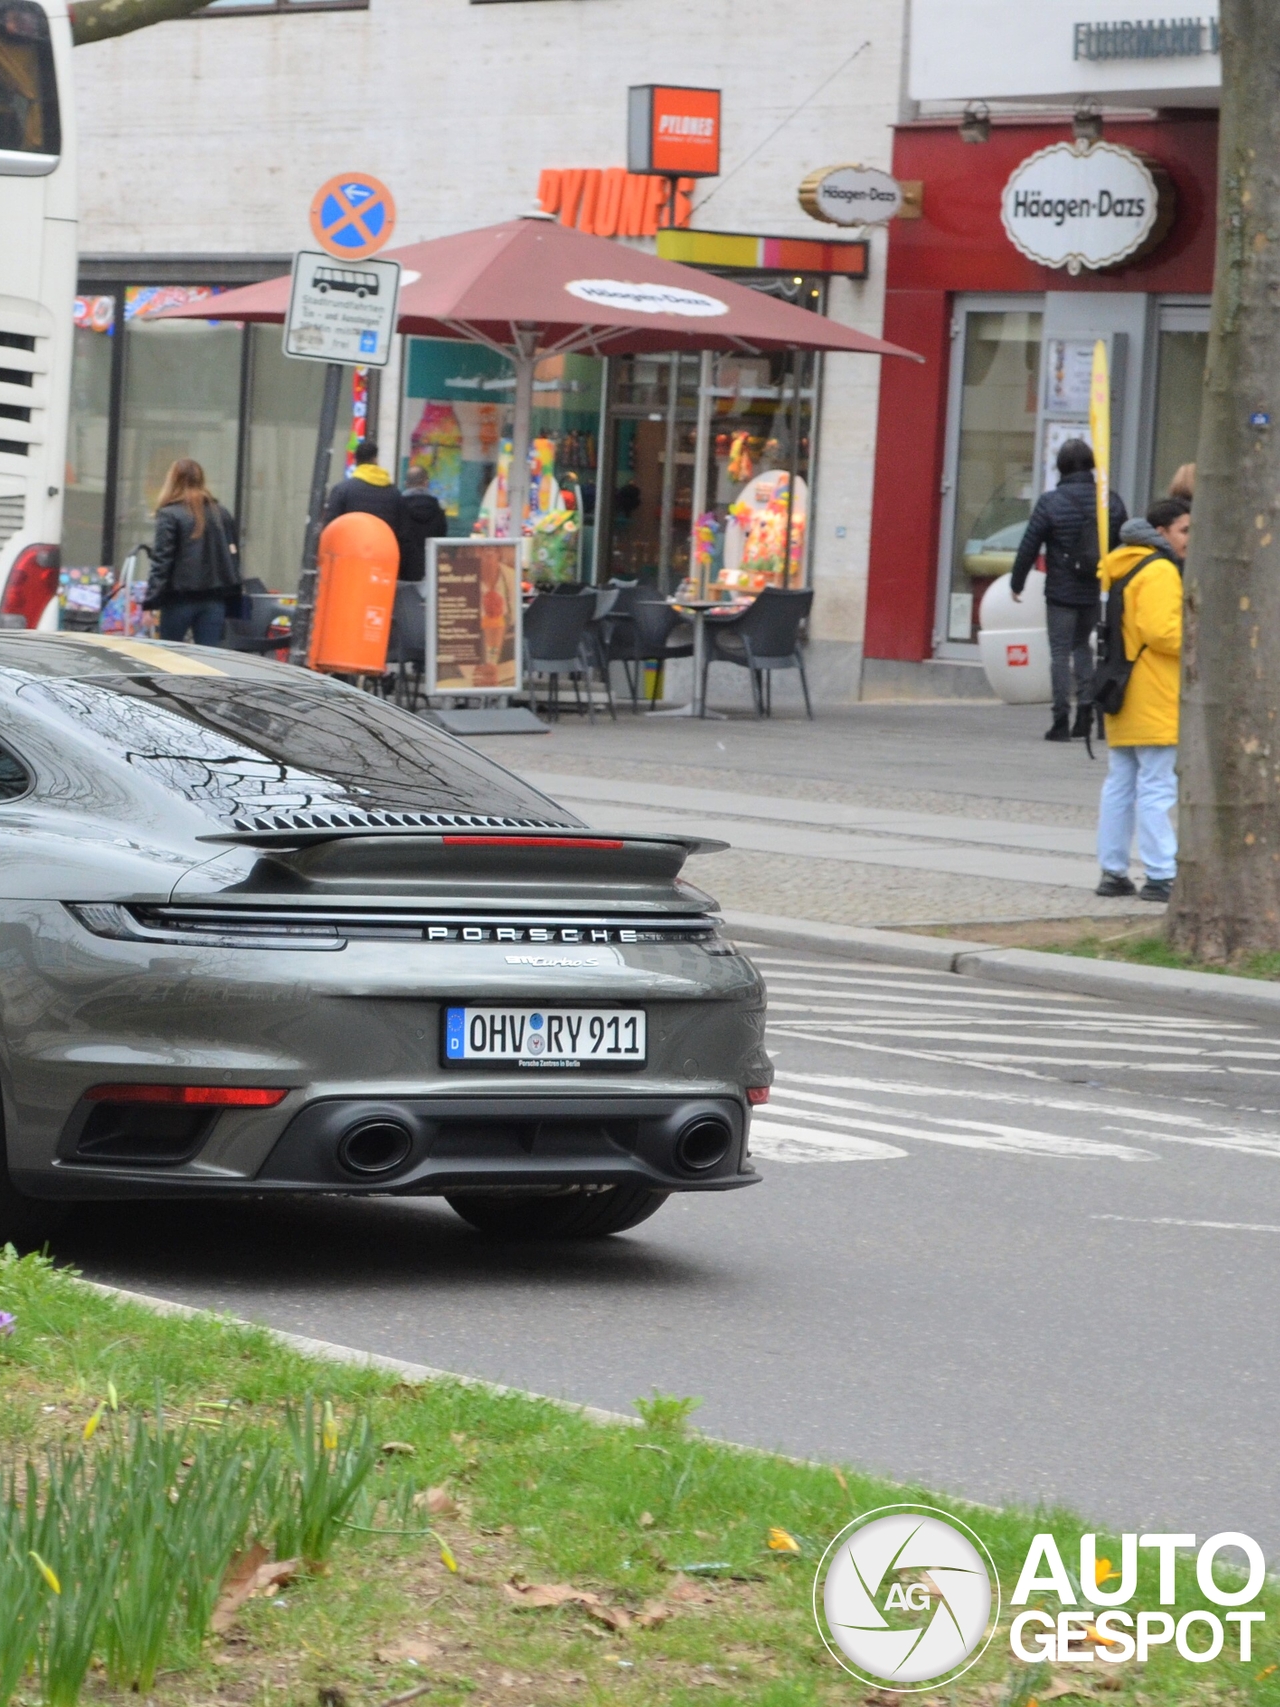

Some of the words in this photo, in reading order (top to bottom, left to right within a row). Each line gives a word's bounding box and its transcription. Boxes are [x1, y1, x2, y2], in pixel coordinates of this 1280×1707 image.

[658, 115, 714, 136] PYLONES
[822, 185, 896, 205] Häagen-Dazs
[1014, 190, 1145, 226] Häagen-Dazs
[428, 927, 637, 942] PORSCHE
[532, 957, 581, 967] turbo
[582, 958, 599, 967] S
[451, 1038, 459, 1049] D
[470, 1015, 525, 1052] OHV
[547, 1015, 582, 1053] RY
[589, 1016, 639, 1053] 911
